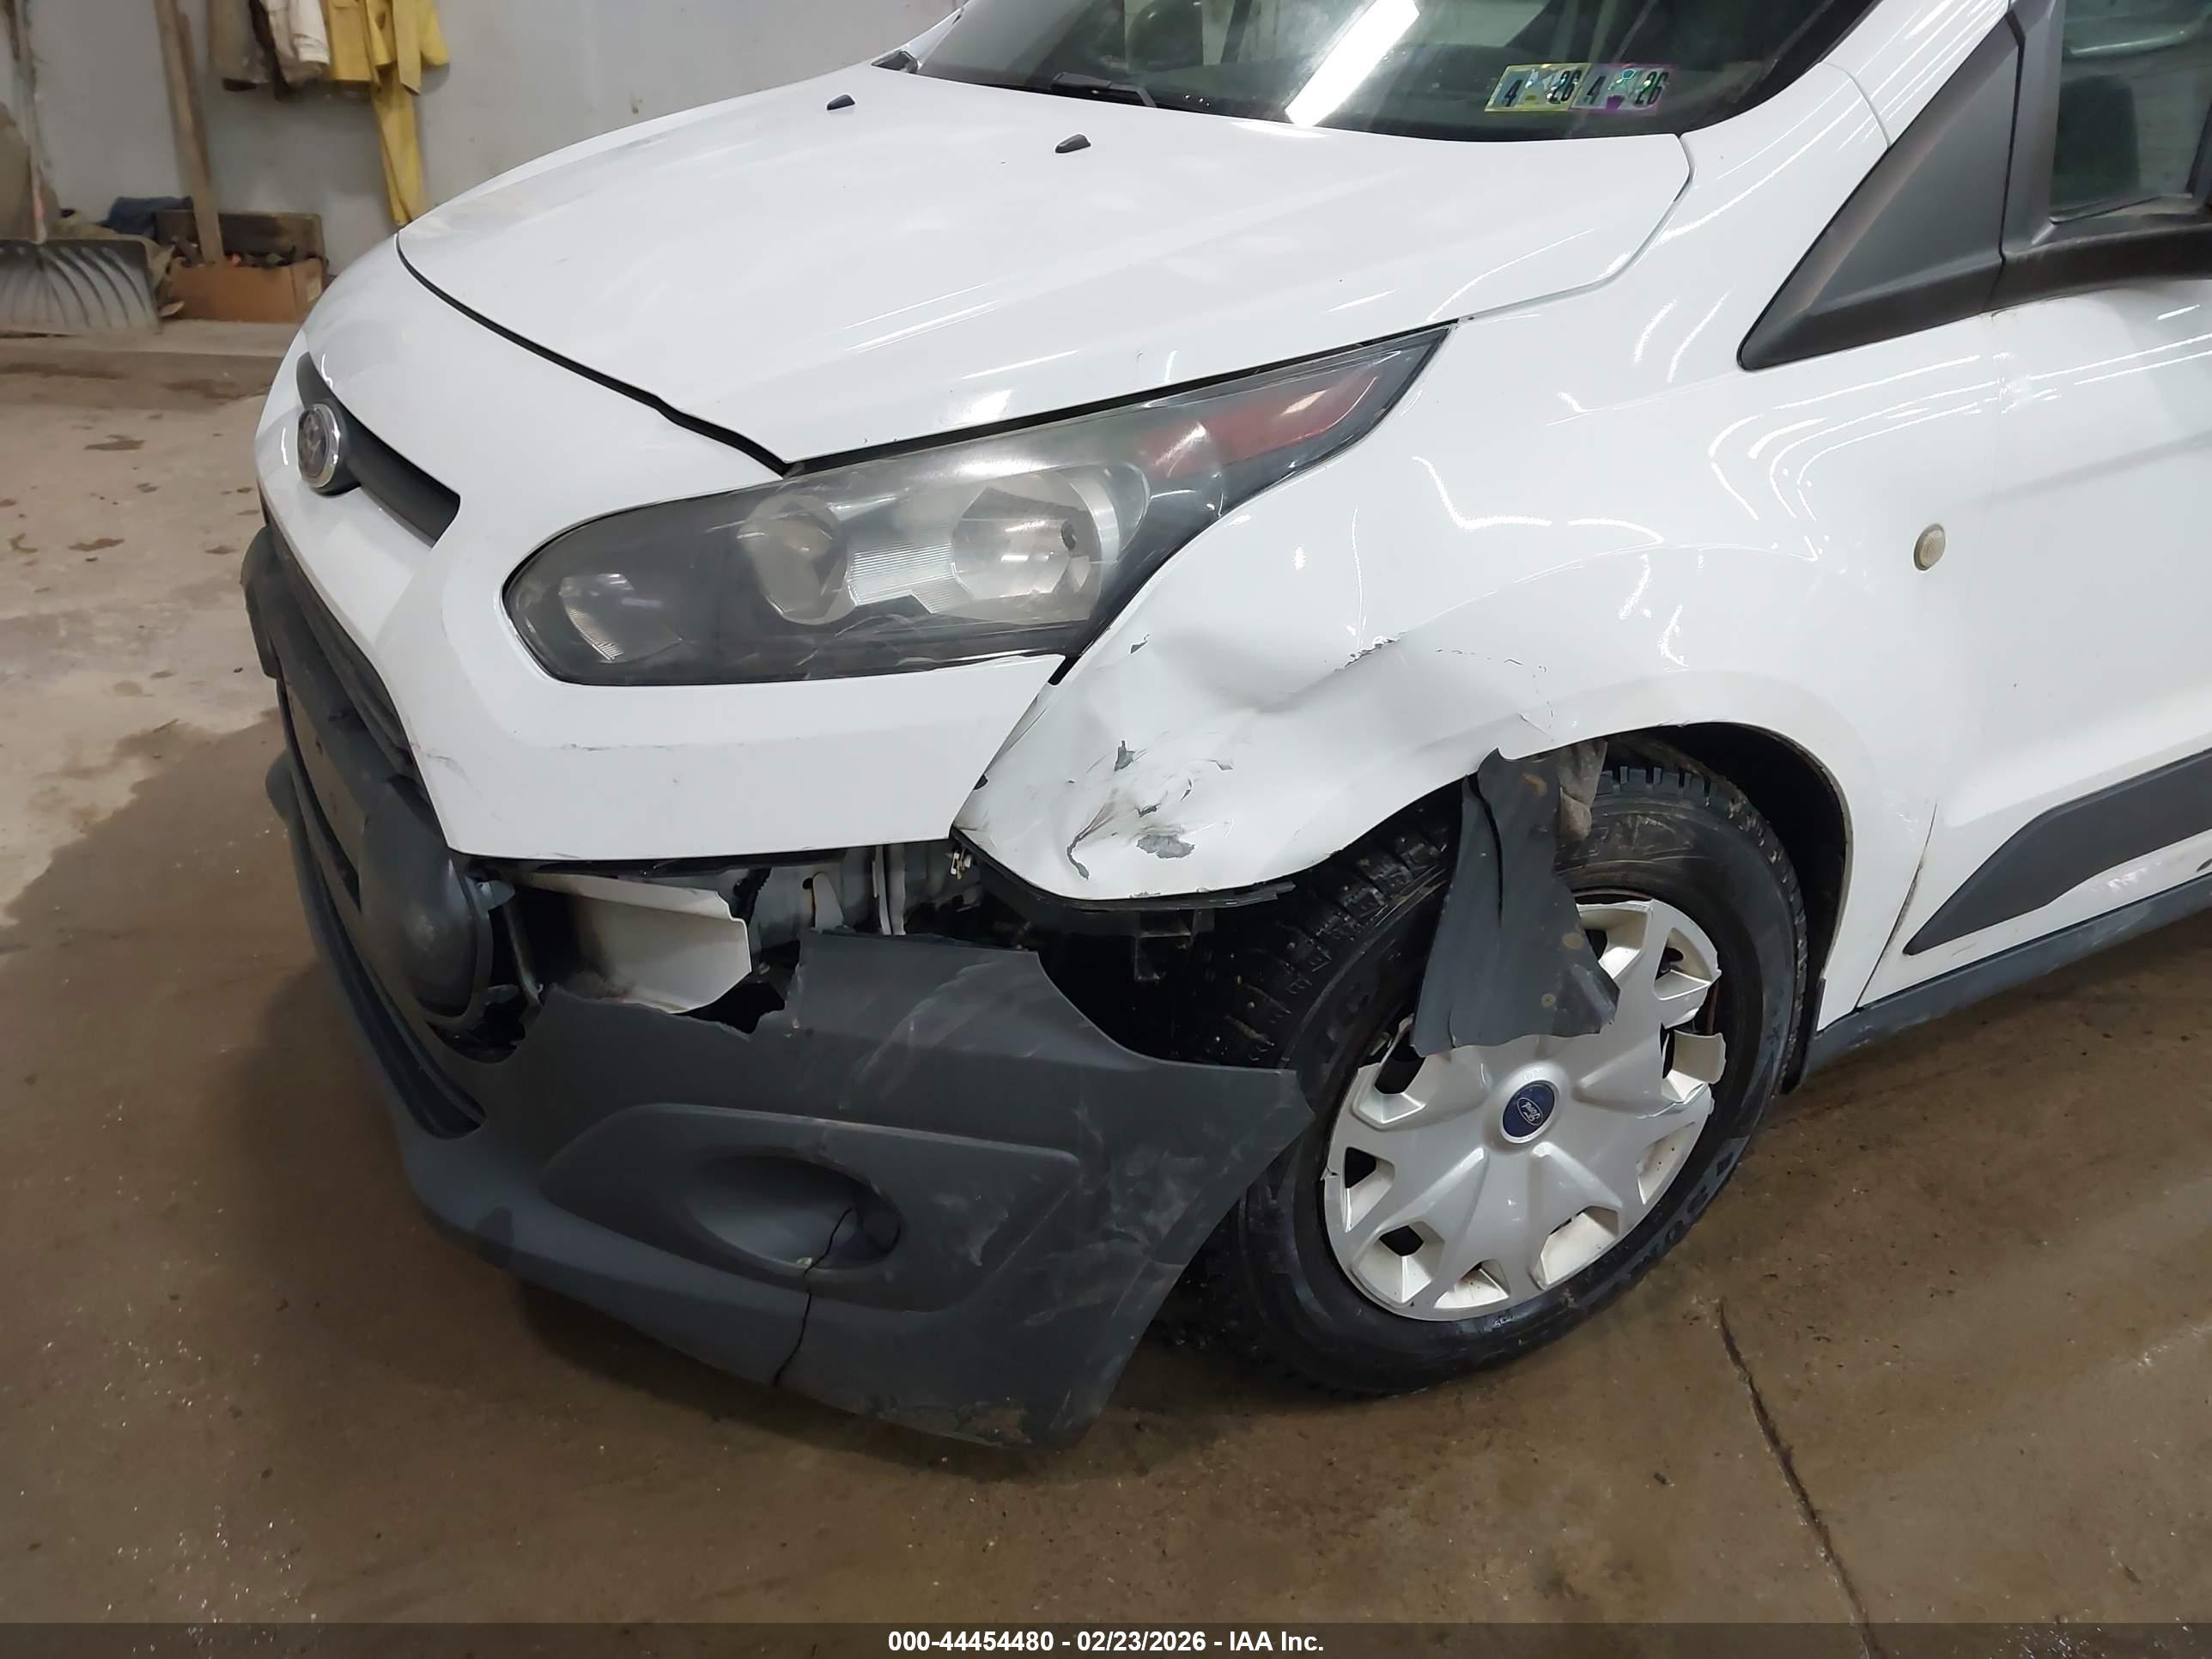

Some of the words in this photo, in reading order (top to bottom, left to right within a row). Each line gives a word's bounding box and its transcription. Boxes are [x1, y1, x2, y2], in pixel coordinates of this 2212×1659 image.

[1504, 79, 1523, 107] 4
[1547, 69, 1582, 105] 26
[1586, 75, 1607, 105] 4
[1633, 70, 1668, 106] 26
[1522, 1102, 1540, 1121] Ford
